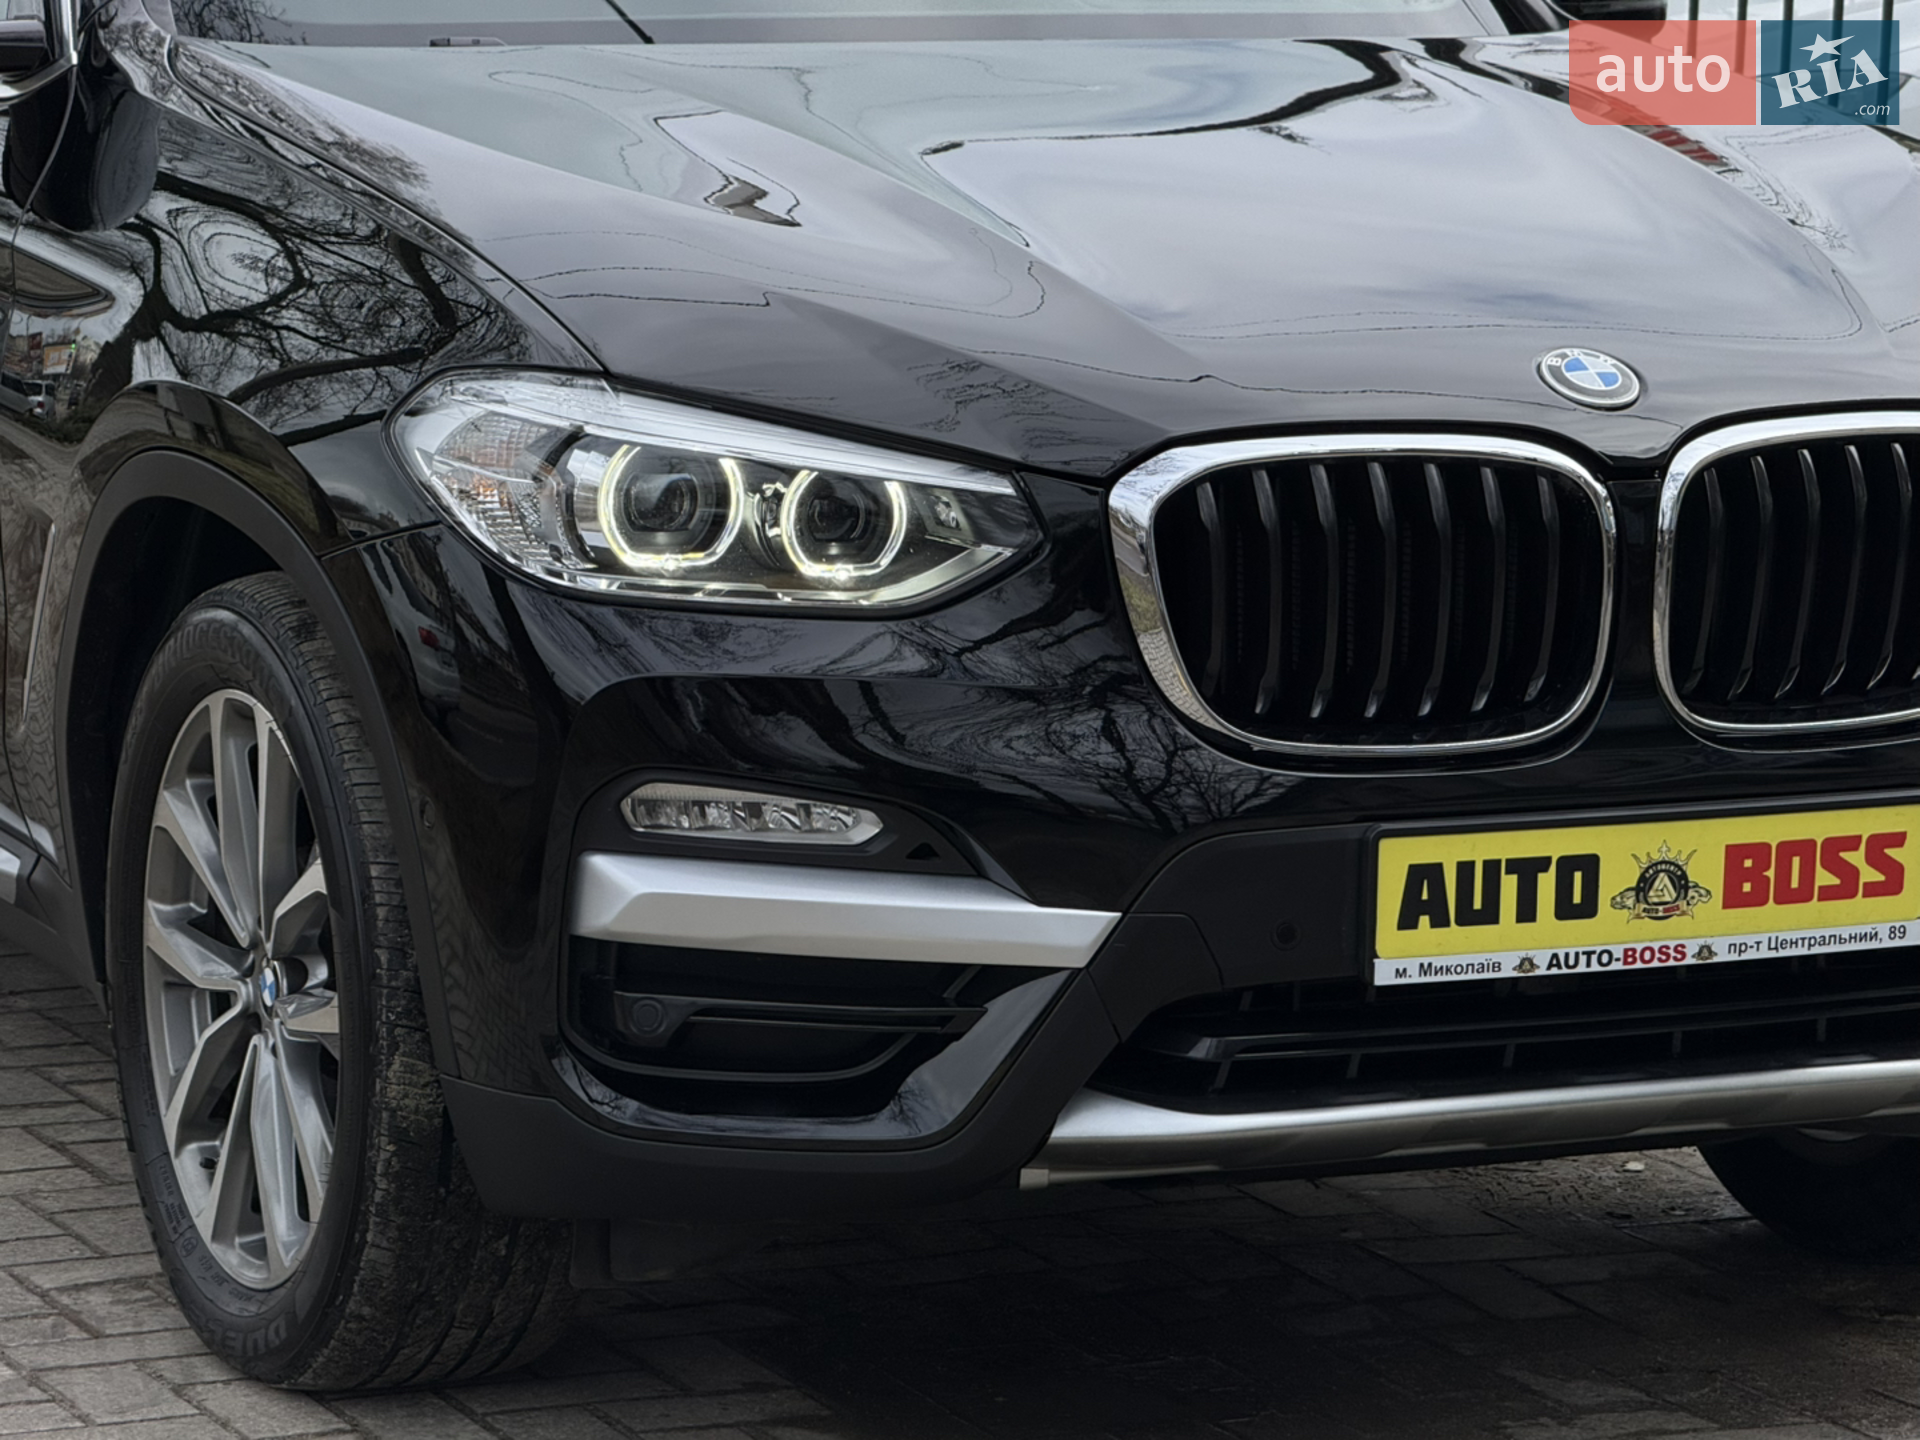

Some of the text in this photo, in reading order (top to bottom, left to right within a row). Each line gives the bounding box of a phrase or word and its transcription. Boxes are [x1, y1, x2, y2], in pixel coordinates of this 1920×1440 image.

[1397, 831, 1907, 931] AUTO BOSS
[1727, 924, 1907, 957] пр-т Центральний, 89
[1394, 958, 1502, 980] м. Миколаїв
[1546, 943, 1687, 971] AUTO-BOSS
